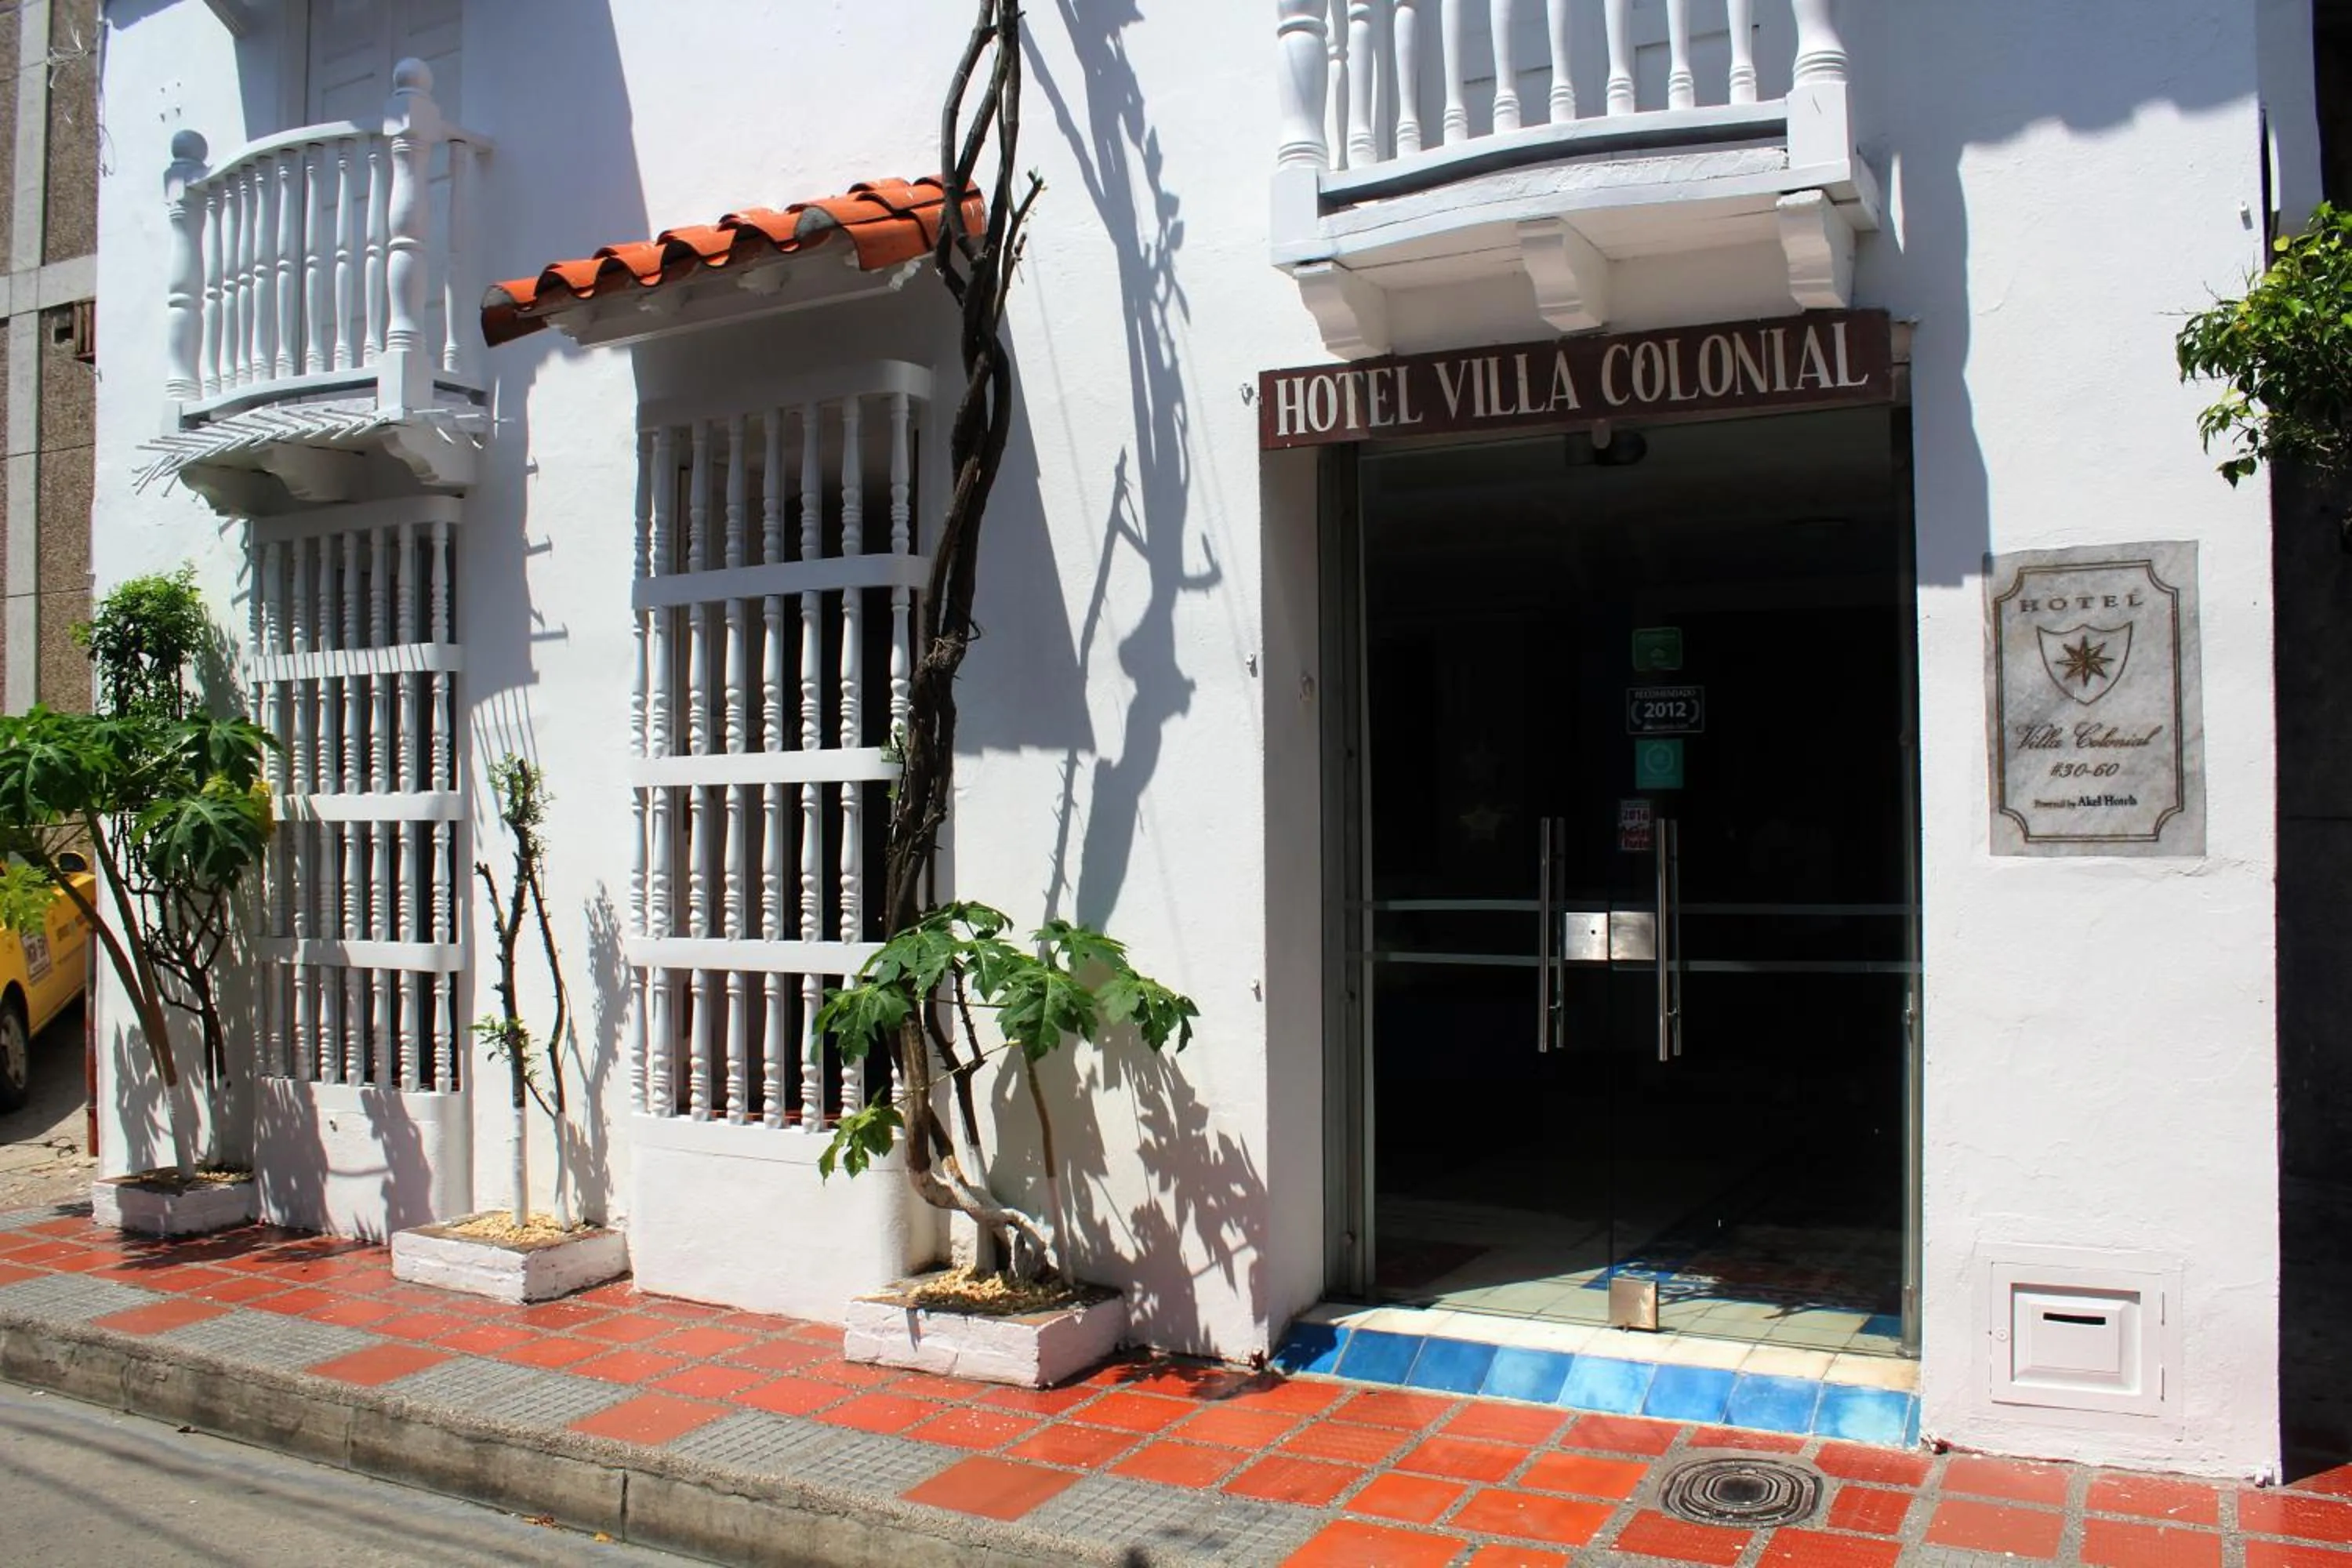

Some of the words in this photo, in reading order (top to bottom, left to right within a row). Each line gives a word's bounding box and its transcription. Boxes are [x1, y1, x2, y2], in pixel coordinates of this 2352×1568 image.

[1275, 365, 1423, 437] HOTEL
[1432, 350, 1581, 419] VILLA
[1601, 321, 1869, 407] COLONIAL
[2020, 593, 2144, 613] HOTEL
[1643, 701, 1687, 718] 2012
[2016, 723, 2063, 750] Villa
[2074, 721, 2163, 749] Colonial
[2050, 761, 2120, 778] #30-60
